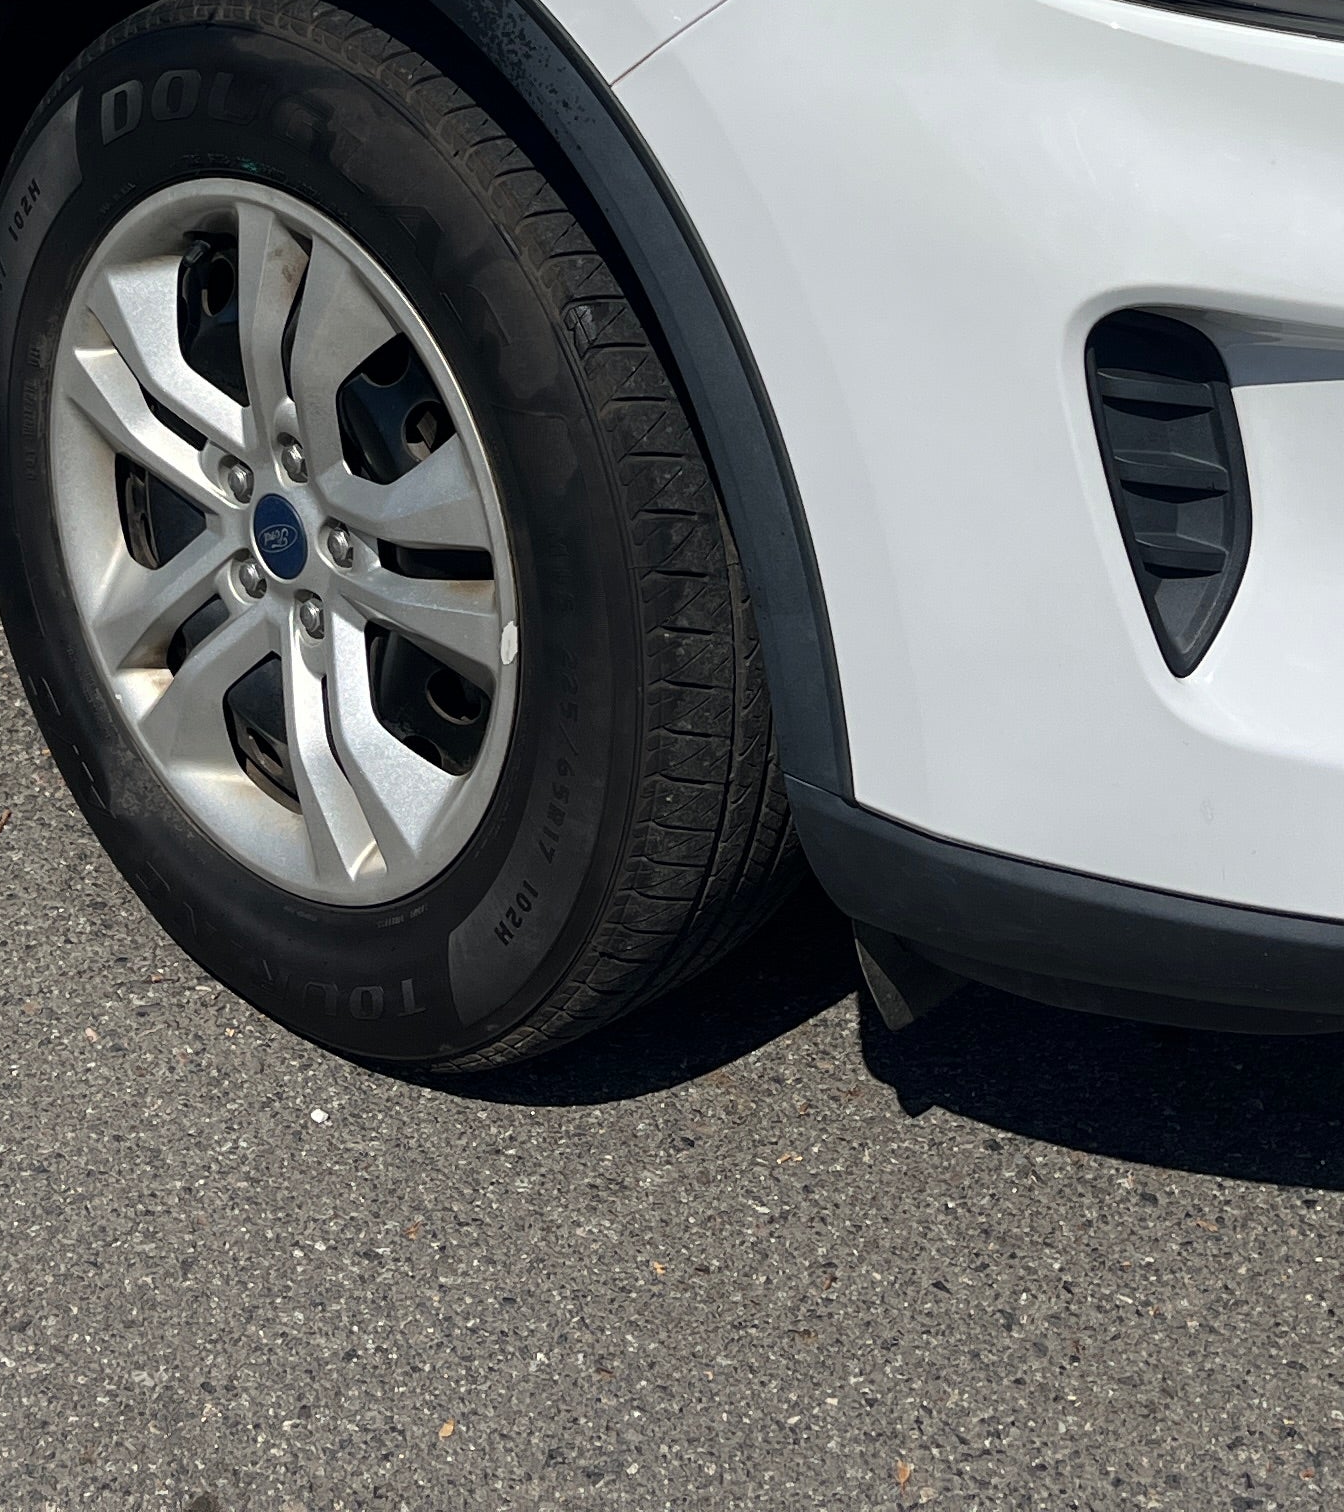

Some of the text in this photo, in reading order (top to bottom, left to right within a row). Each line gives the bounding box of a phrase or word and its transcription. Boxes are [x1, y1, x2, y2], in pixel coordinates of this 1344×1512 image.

[7, 178, 41, 242] 102H
[262, 526, 290, 550] Ford
[493, 879, 540, 946] 102H
